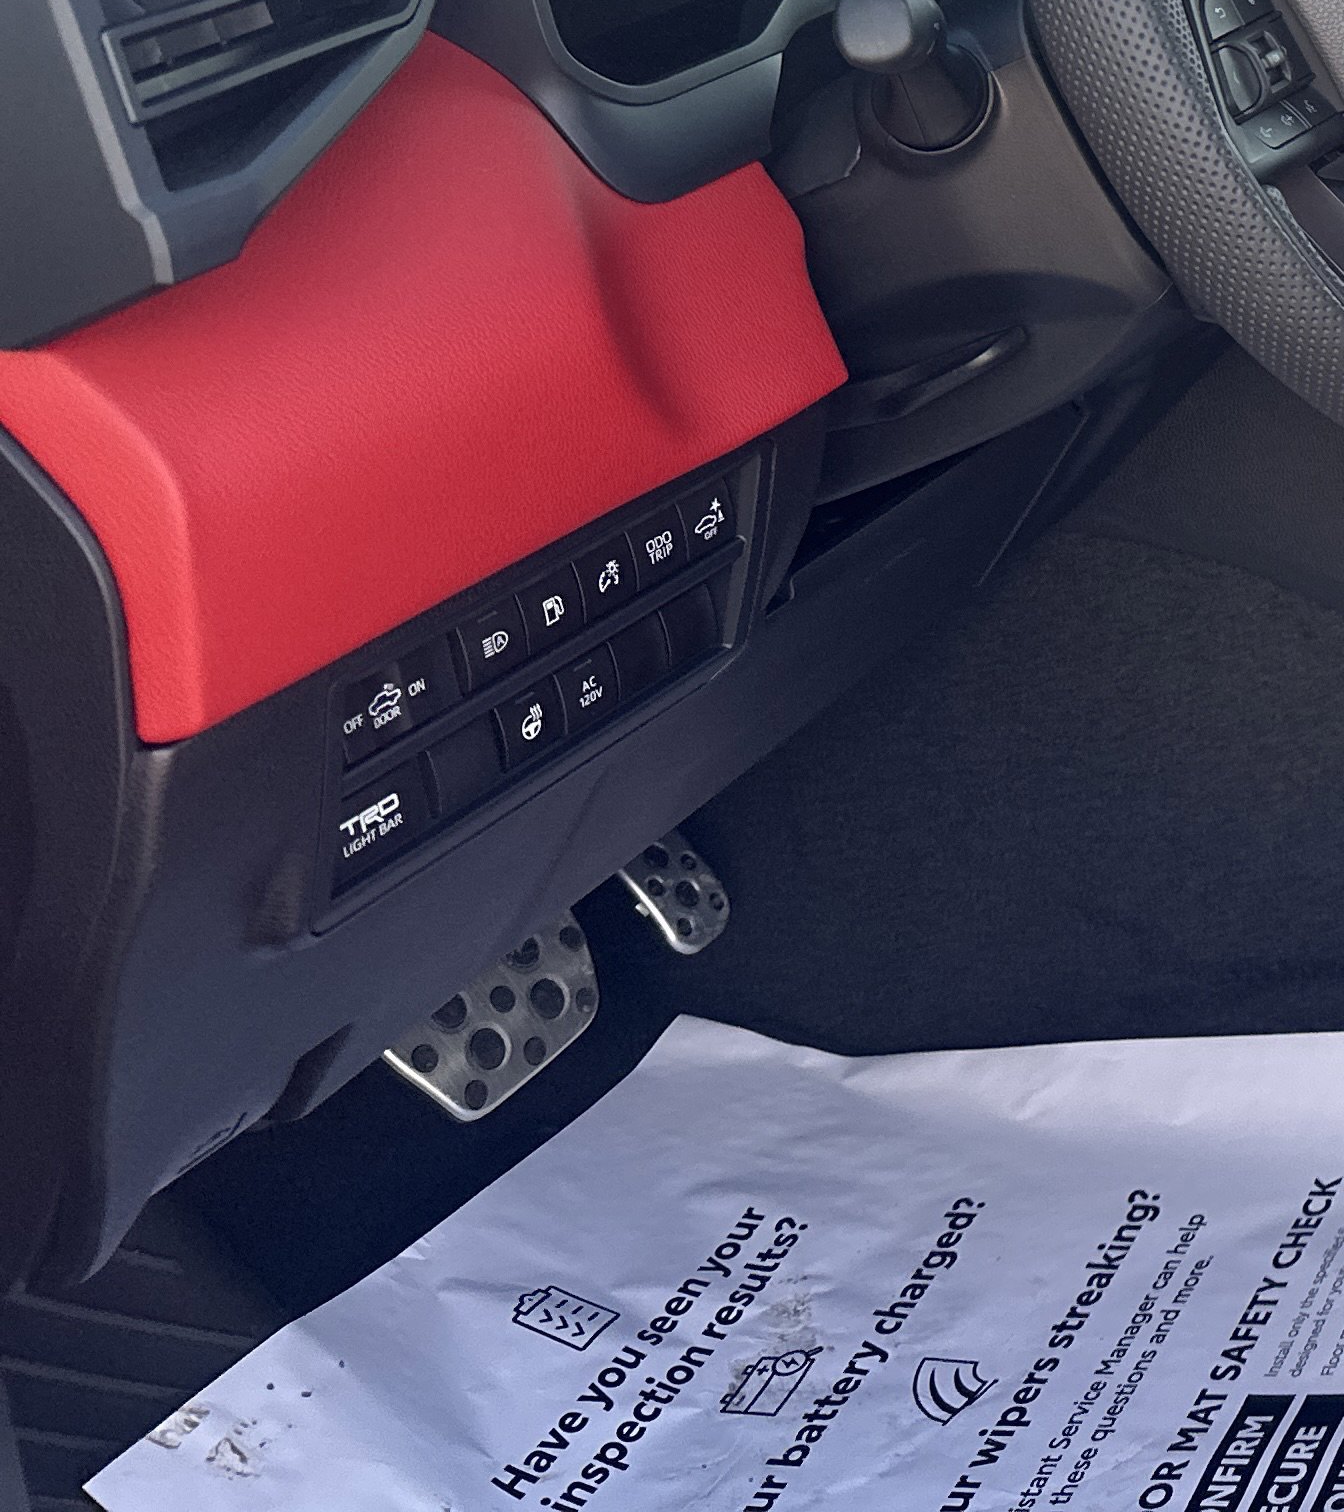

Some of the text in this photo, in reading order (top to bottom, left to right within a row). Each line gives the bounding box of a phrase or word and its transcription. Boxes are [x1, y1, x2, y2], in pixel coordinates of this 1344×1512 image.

[645, 530, 672, 553] ODO
[648, 542, 673, 565] TRIP
[407, 678, 426, 697] ON
[579, 686, 603, 708] 120V
[582, 675, 597, 693] AC
[343, 713, 364, 735] OFF
[373, 705, 402, 729] DOOR
[339, 792, 400, 836] TRD
[343, 812, 404, 859] LIGHT BAR
[1166, 1213, 1208, 1255] help
[1152, 1259, 1182, 1290] can
[491, 1206, 765, 1500] Have you seen your
[766, 1340, 889, 1467] battery
[873, 1196, 986, 1335] charged?
[968, 1357, 1060, 1468] wipers
[1049, 1189, 1161, 1349] streaking?
[1094, 1293, 1159, 1376] Manager
[1139, 1176, 1343, 1512] OR MAT SAFETY CHECK
[1264, 1341, 1294, 1377] Install
[1288, 1311, 1309, 1338] only
[1300, 1288, 1319, 1309] the
[1289, 1317, 1326, 1378] designed
[1316, 1297, 1335, 1316] for
[540, 1216, 808, 1512] inspection results?
[1049, 1254, 1214, 1505] these questions and more.
[1049, 1379, 1107, 1449] Service
[1199, 1414, 1275, 1512] NFIRM
